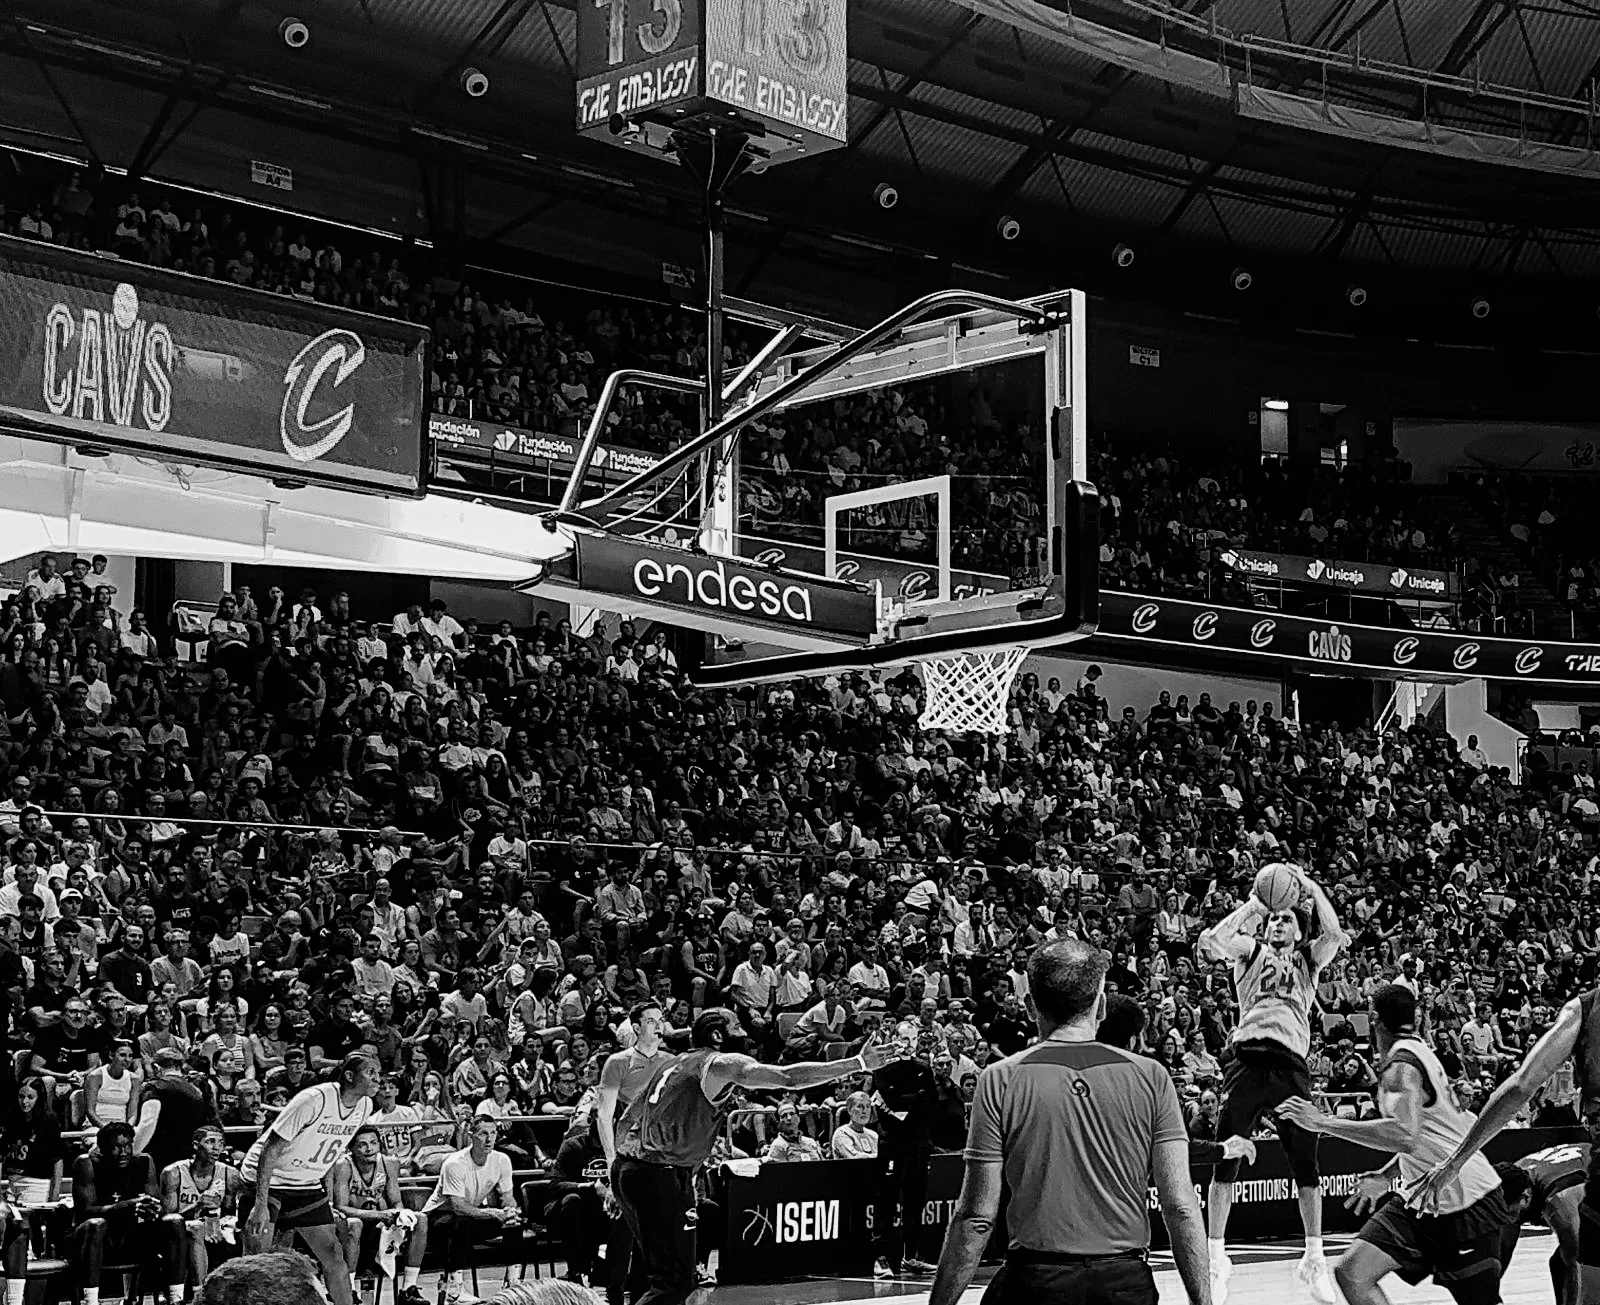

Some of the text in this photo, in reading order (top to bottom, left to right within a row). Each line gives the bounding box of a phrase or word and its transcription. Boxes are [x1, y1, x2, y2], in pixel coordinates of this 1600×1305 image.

[580, 57, 697, 124] THE EMBASSY
[710, 60, 845, 133] THE EMBASSY
[43, 300, 173, 431] CAVS
[429, 420, 480, 439] undación
[519, 434, 573, 454] Fundación
[1239, 557, 1279, 576] Unicaja
[1326, 567, 1364, 585] Unicaja
[634, 558, 812, 622] endesa
[1409, 576, 1445, 593] Unicaja
[1309, 628, 1352, 661] CAVS
[1261, 965, 1295, 994] 24
[308, 1138, 342, 1164] 16
[776, 1200, 839, 1243] ISEM
